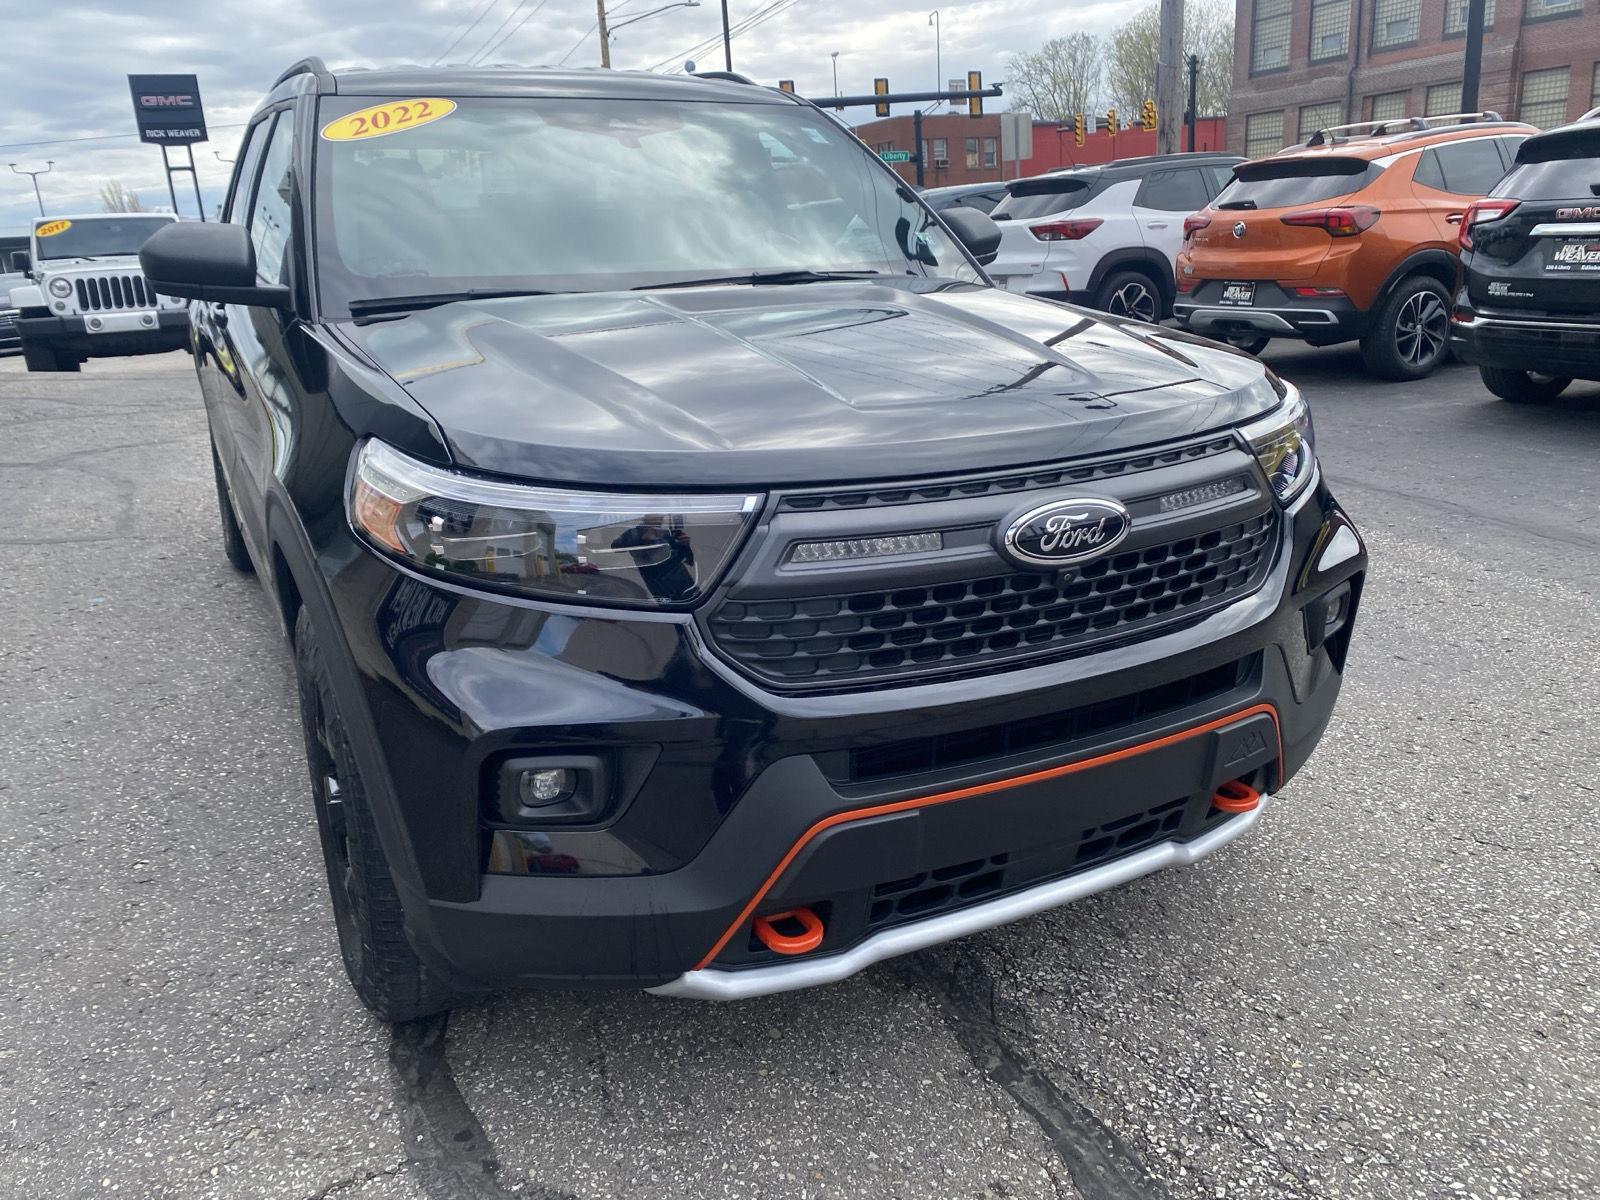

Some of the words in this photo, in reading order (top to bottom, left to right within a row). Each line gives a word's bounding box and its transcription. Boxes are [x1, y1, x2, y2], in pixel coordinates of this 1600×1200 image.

[140, 95, 194, 106] GMC
[349, 101, 433, 137] 2022
[145, 129, 165, 138] RICK
[166, 128, 201, 137] WEAVER
[40, 221, 65, 235] 2017
[1040, 512, 1106, 552] Ford
